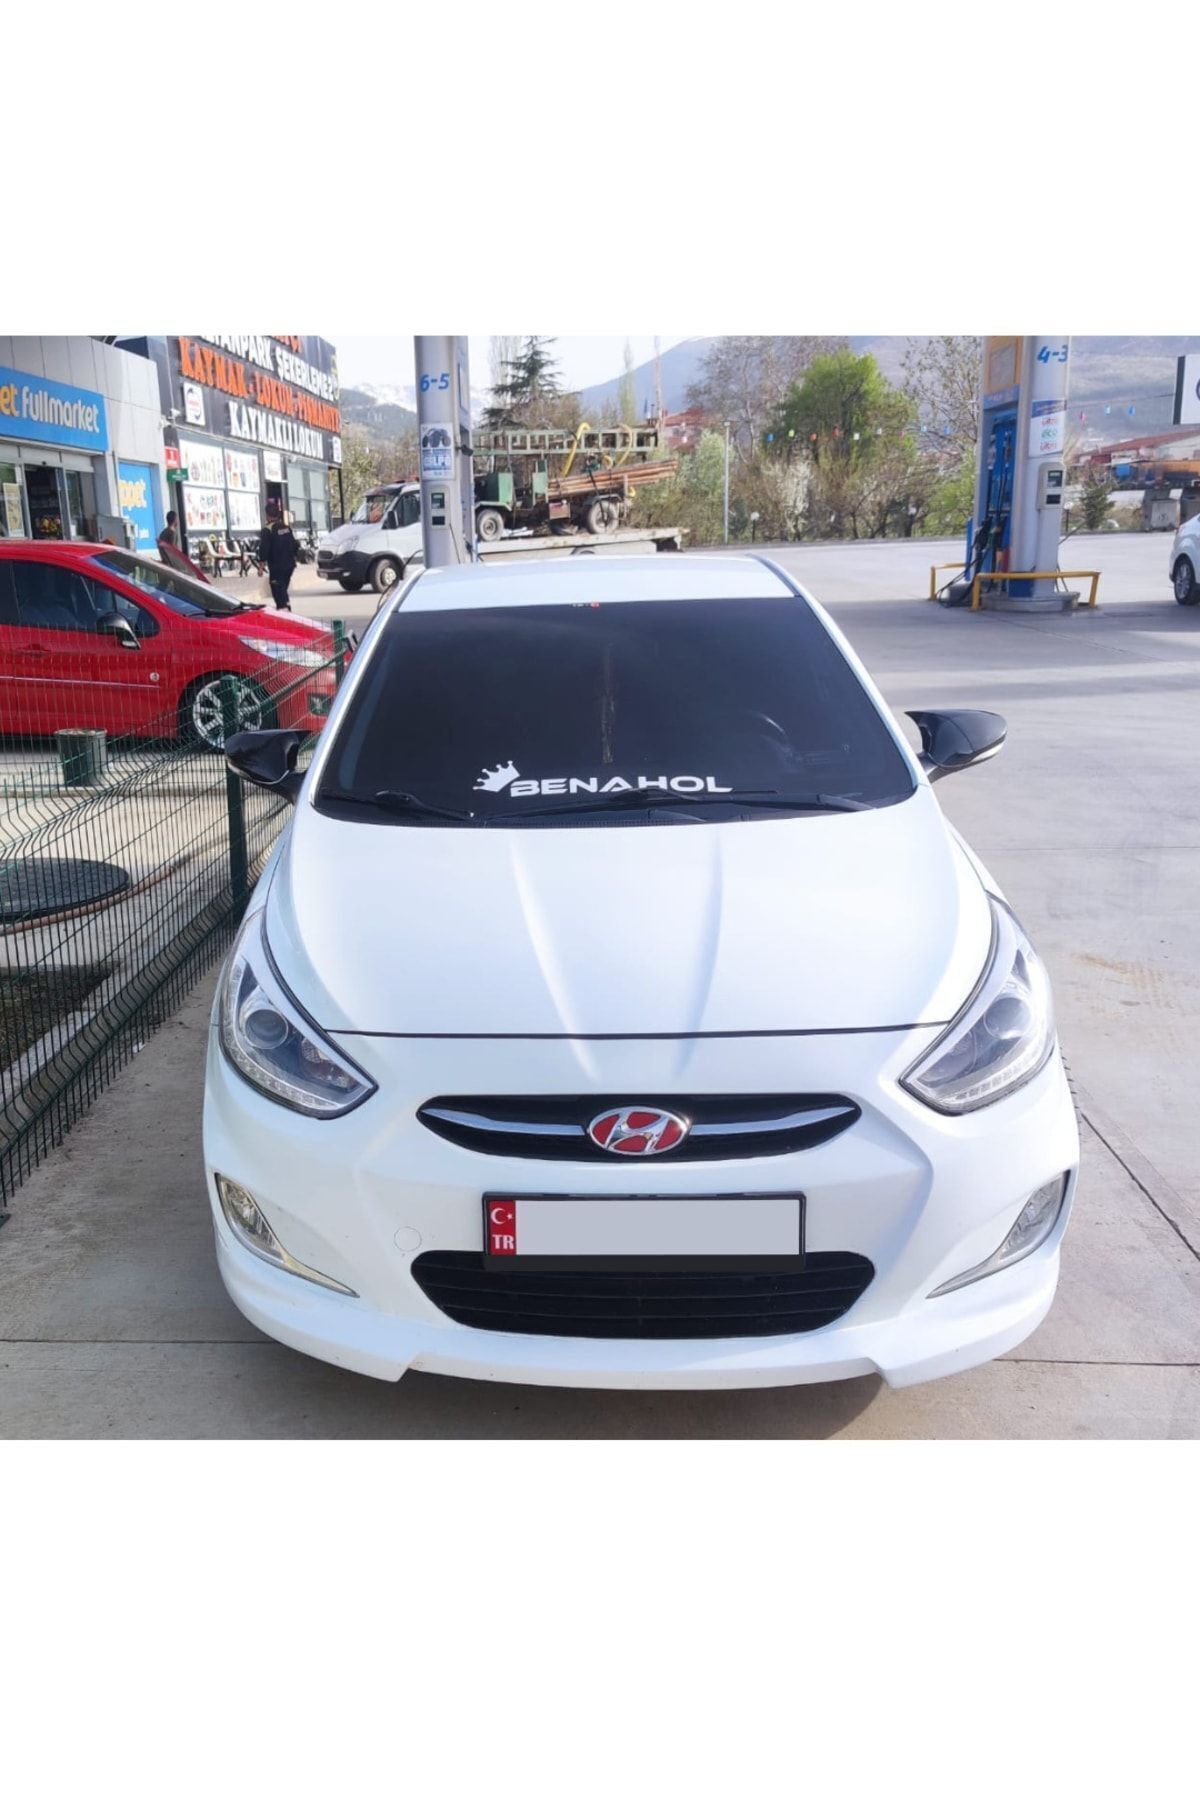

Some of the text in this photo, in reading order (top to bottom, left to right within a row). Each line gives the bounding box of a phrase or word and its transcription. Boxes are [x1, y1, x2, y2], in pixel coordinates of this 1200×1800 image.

[1037, 345, 1069, 364] 4-3
[179, 335, 248, 399] KAYMAK
[420, 373, 450, 393] 6-5
[22, 386, 100, 433] fullmarket
[510, 775, 733, 797] BENAHOL
[492, 1234, 514, 1250] TR
